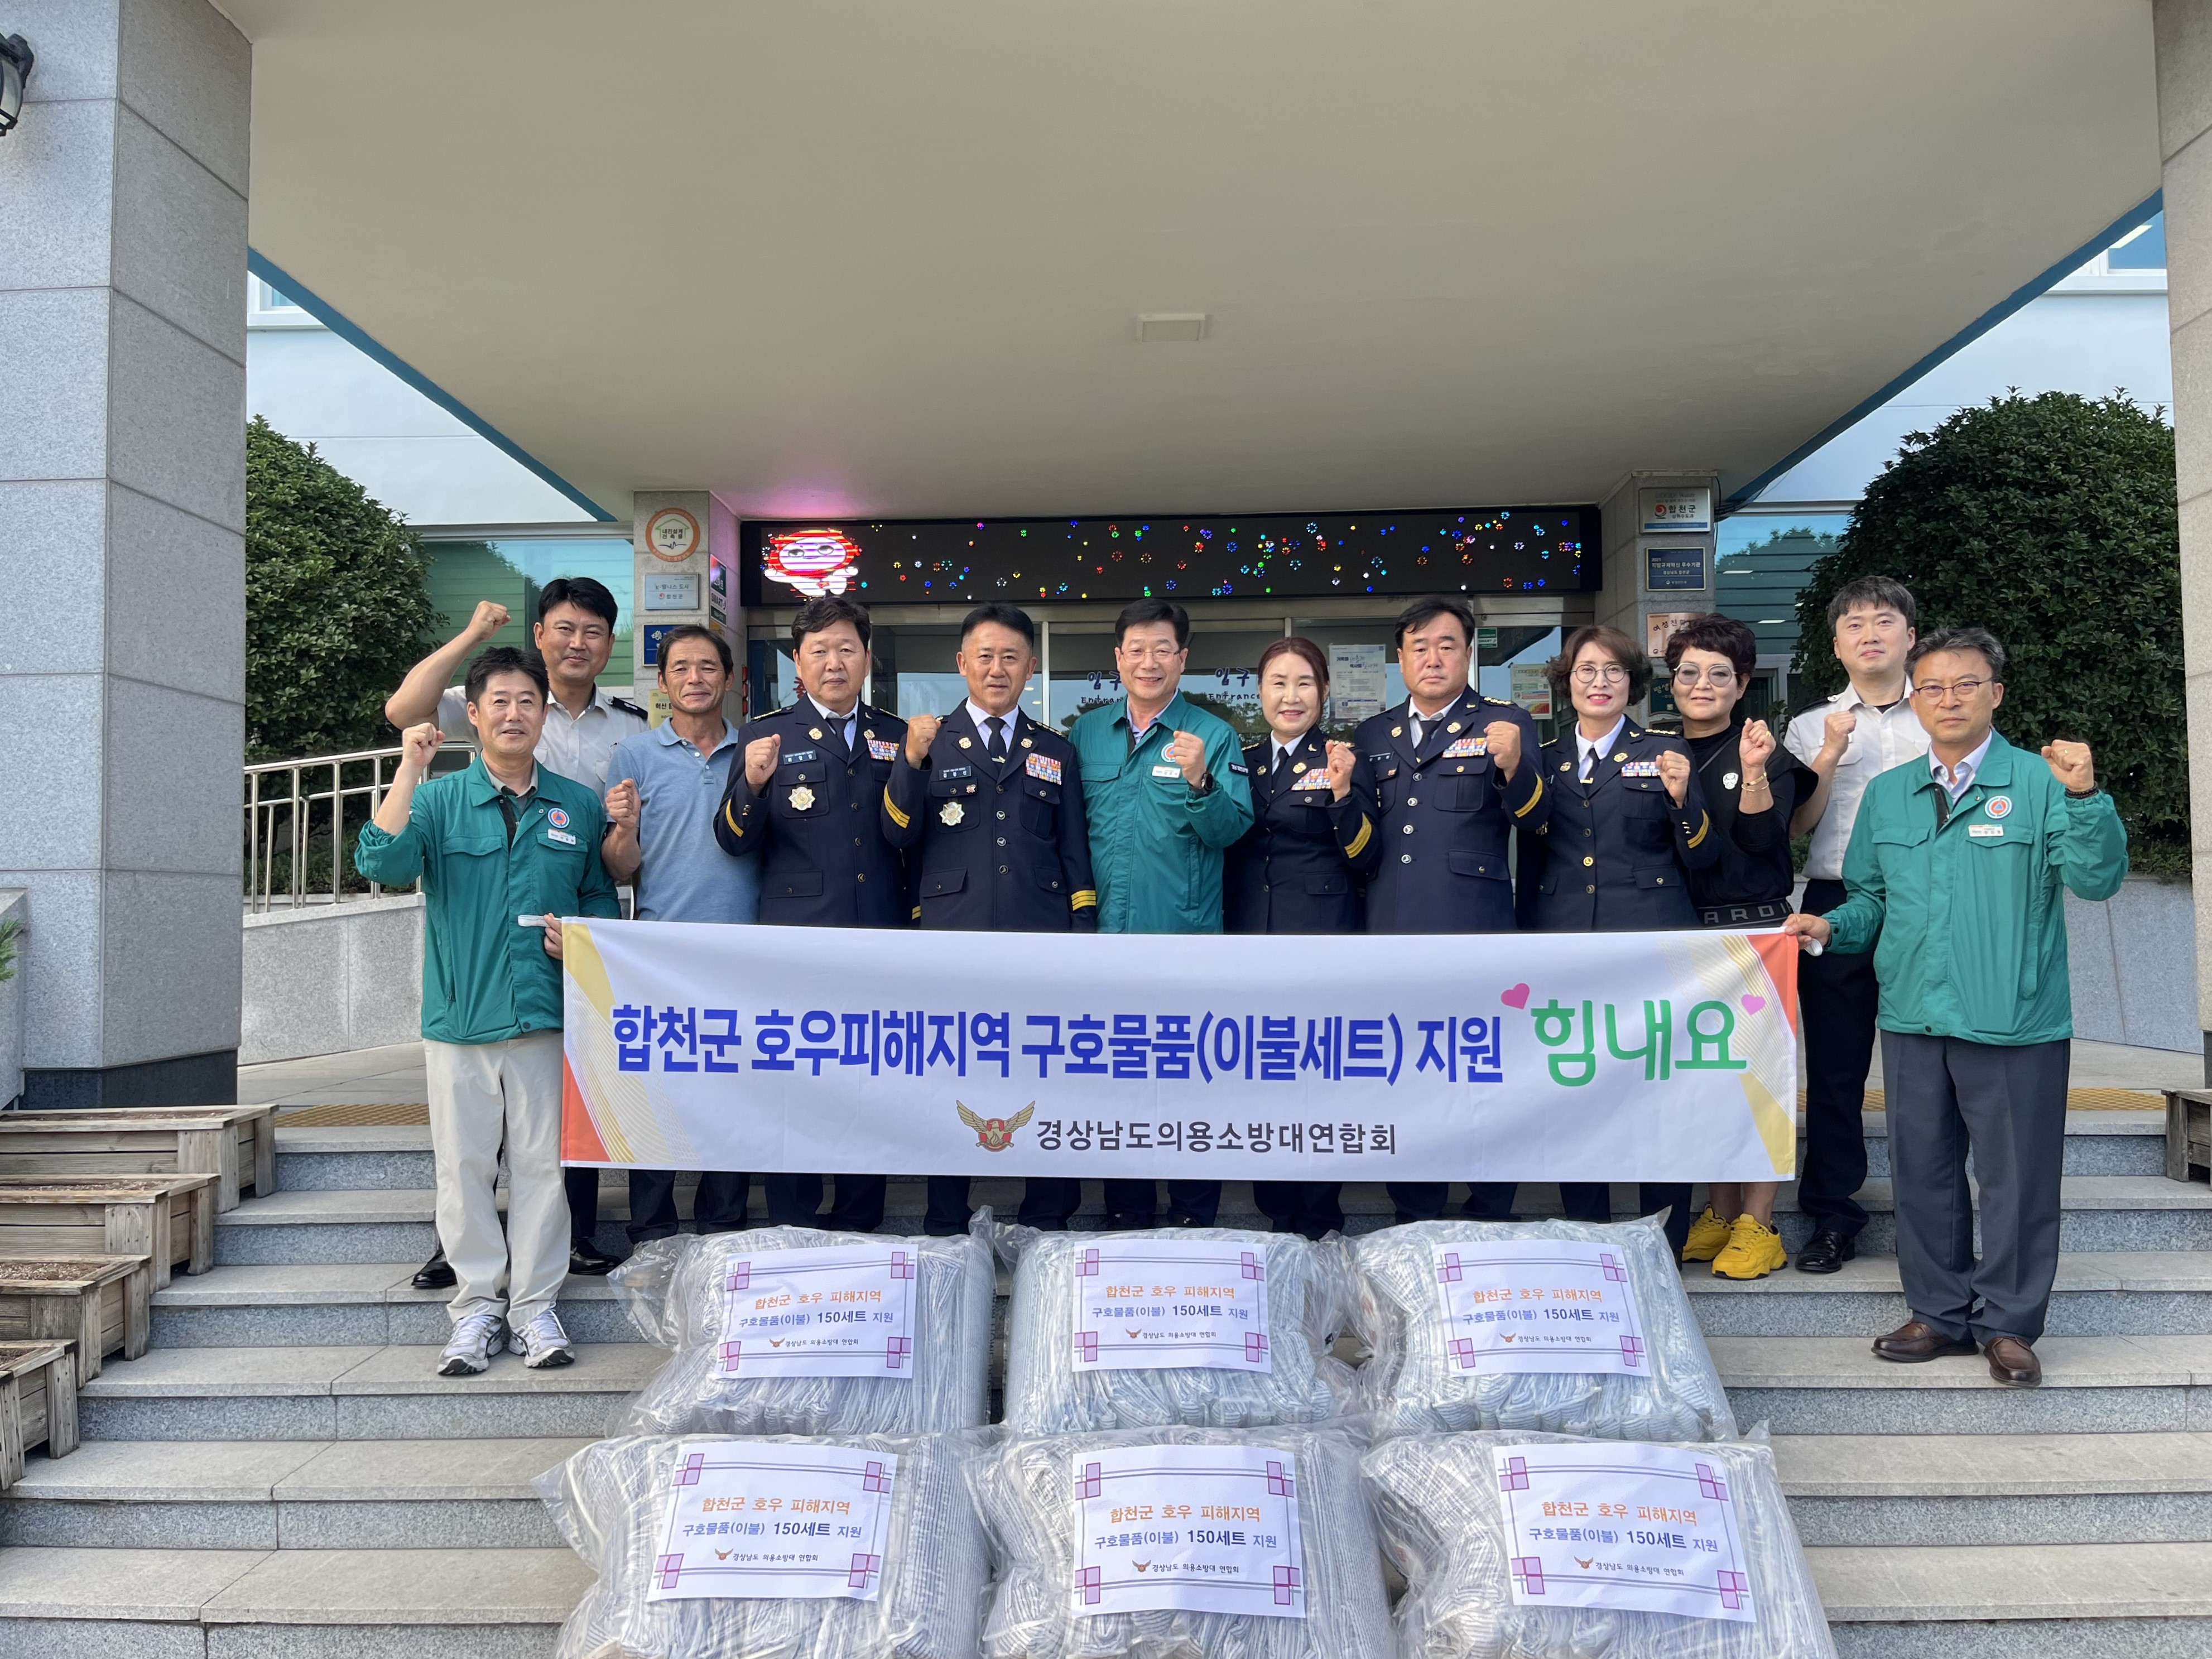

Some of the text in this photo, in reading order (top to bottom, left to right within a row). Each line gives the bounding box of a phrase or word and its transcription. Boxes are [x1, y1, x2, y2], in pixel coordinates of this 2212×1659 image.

[1668, 504, 1696, 513] 합천군
[1215, 667, 1250, 687] 입구
[613, 999, 1747, 1087] 합천군 호우피해지역 구호물품(이불세트) 지원 힘내요
[1036, 1119, 1396, 1155] 경상남도의용소방대연합회
[755, 1291, 881, 1310] 합천군 호우 피해지역
[1106, 1286, 1234, 1299] 합천군 호우 피해지역
[1473, 1288, 1602, 1304] 합천군 호우 피해지역
[739, 1311, 893, 1327] 구호물품(이불) 150세트 지원
[1092, 1305, 1248, 1319] 구호물품(이불) 150세트 지원
[1463, 1309, 1619, 1324] 구호물품(이불) 150세트 지원
[702, 1497, 850, 1514] 합천군 호우 피해지역
[1110, 1504, 1260, 1523] 합천군 호우 피해지역
[1542, 1501, 1696, 1526] 합천군 호우 피해지역
[682, 1522, 861, 1537] 구호물품(이불) 150세트 지원
[1094, 1530, 1276, 1549] 구호물품(이불) 150세트 지원
[1529, 1528, 1718, 1552] 구호물품(이불) 150세트 지원
[733, 1552, 758, 1561] 경상남도
[1152, 1564, 1239, 1573] 경상남도 의용소방대 연합회
[1595, 1562, 1684, 1576] 경상남도 의용소방대 연합회
